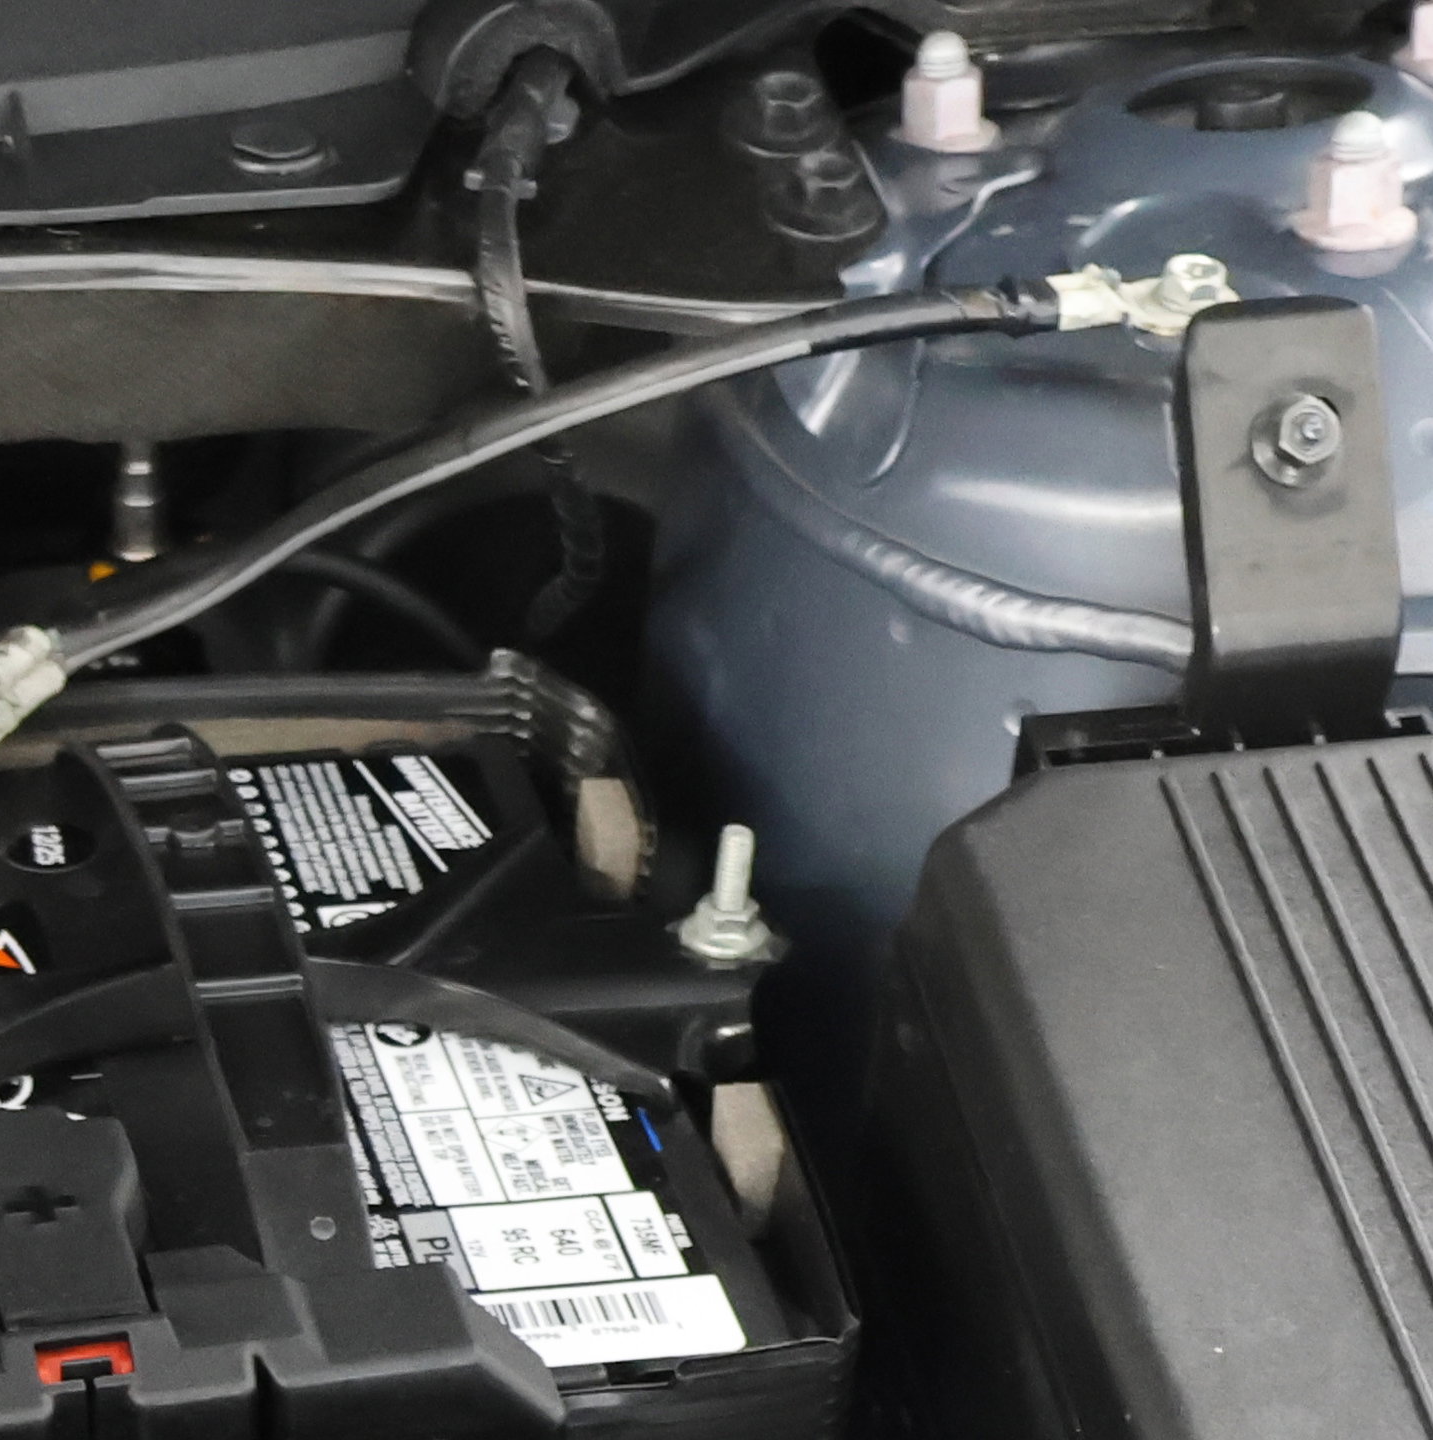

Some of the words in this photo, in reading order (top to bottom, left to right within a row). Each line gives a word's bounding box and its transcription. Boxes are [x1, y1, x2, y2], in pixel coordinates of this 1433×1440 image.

[590, 1078, 632, 1121] SON
[584, 1209, 606, 1235] CCA
[508, 1245, 540, 1265] RC
[550, 1229, 585, 1256] 640
